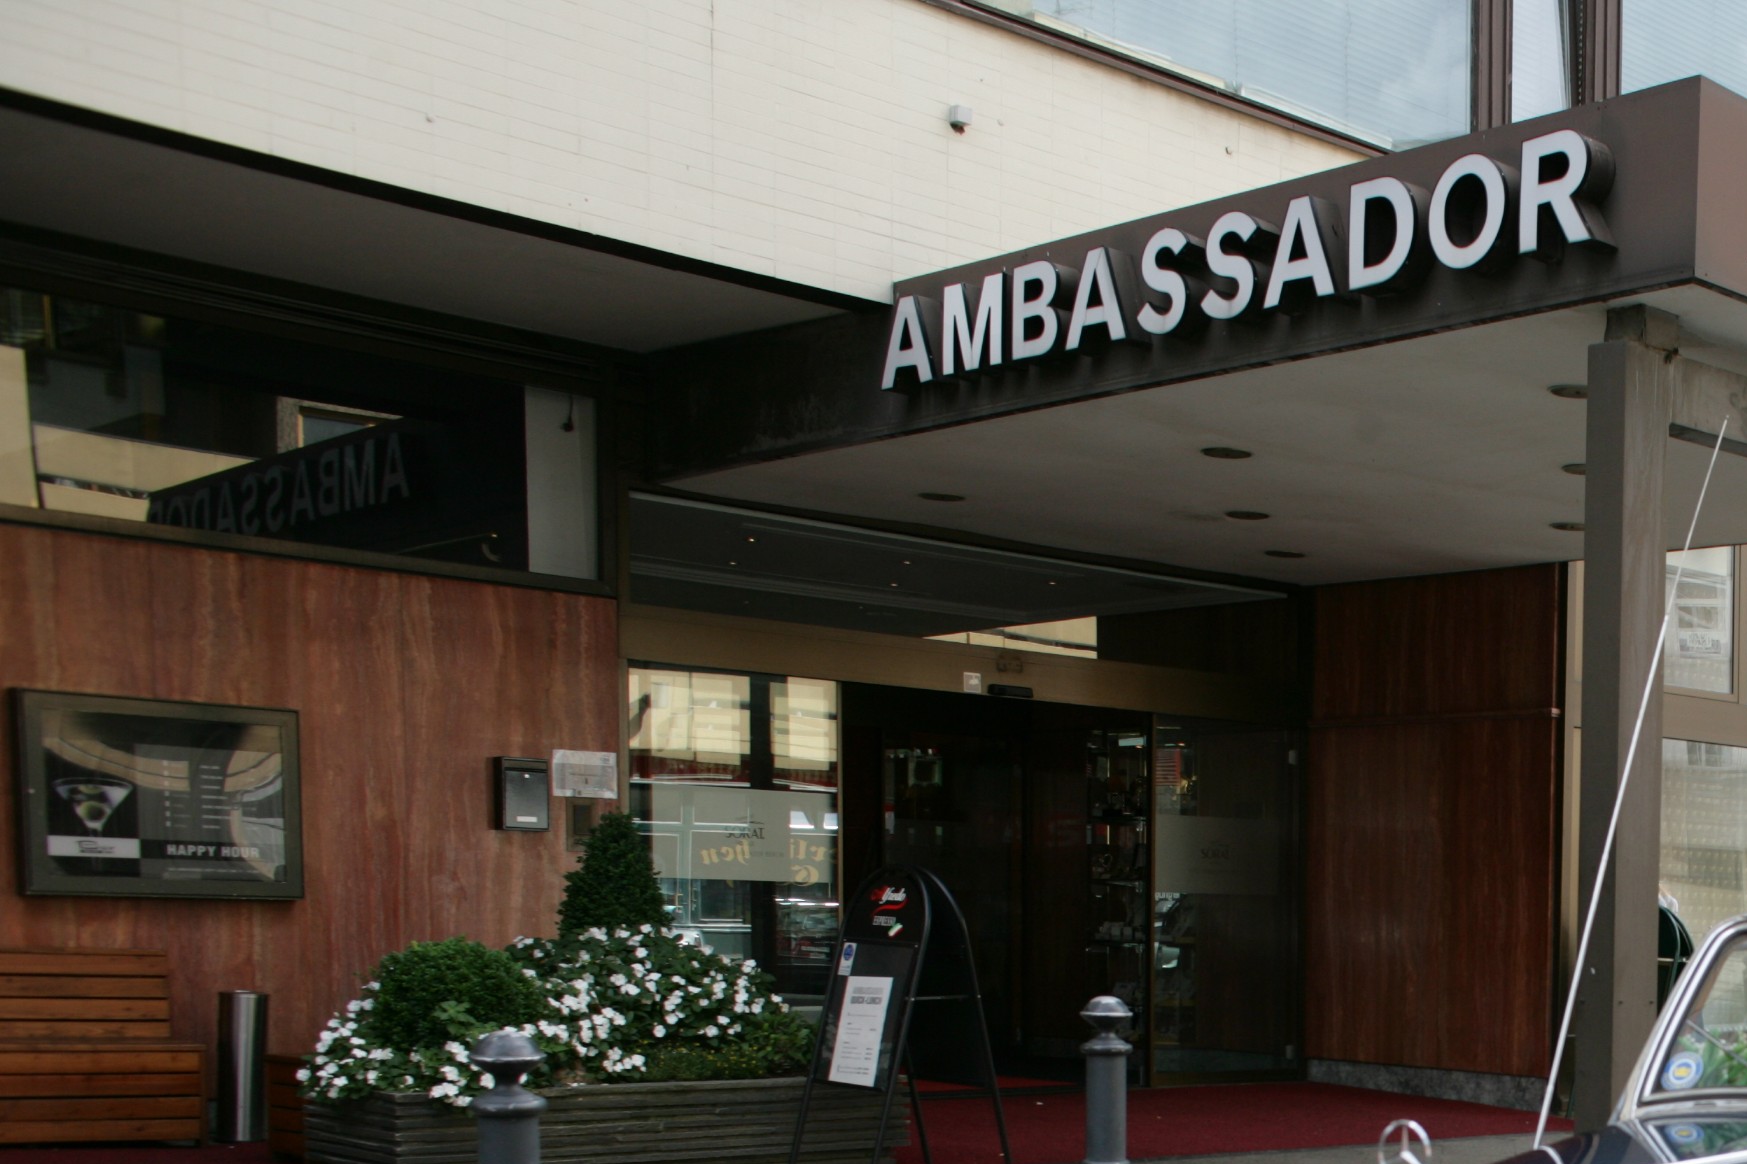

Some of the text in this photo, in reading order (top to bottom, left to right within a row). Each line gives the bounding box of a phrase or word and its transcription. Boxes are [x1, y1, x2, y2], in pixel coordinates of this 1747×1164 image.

[881, 128, 1594, 391] AMBASSADOR
[166, 843, 260, 859] HAPPY HOUR
